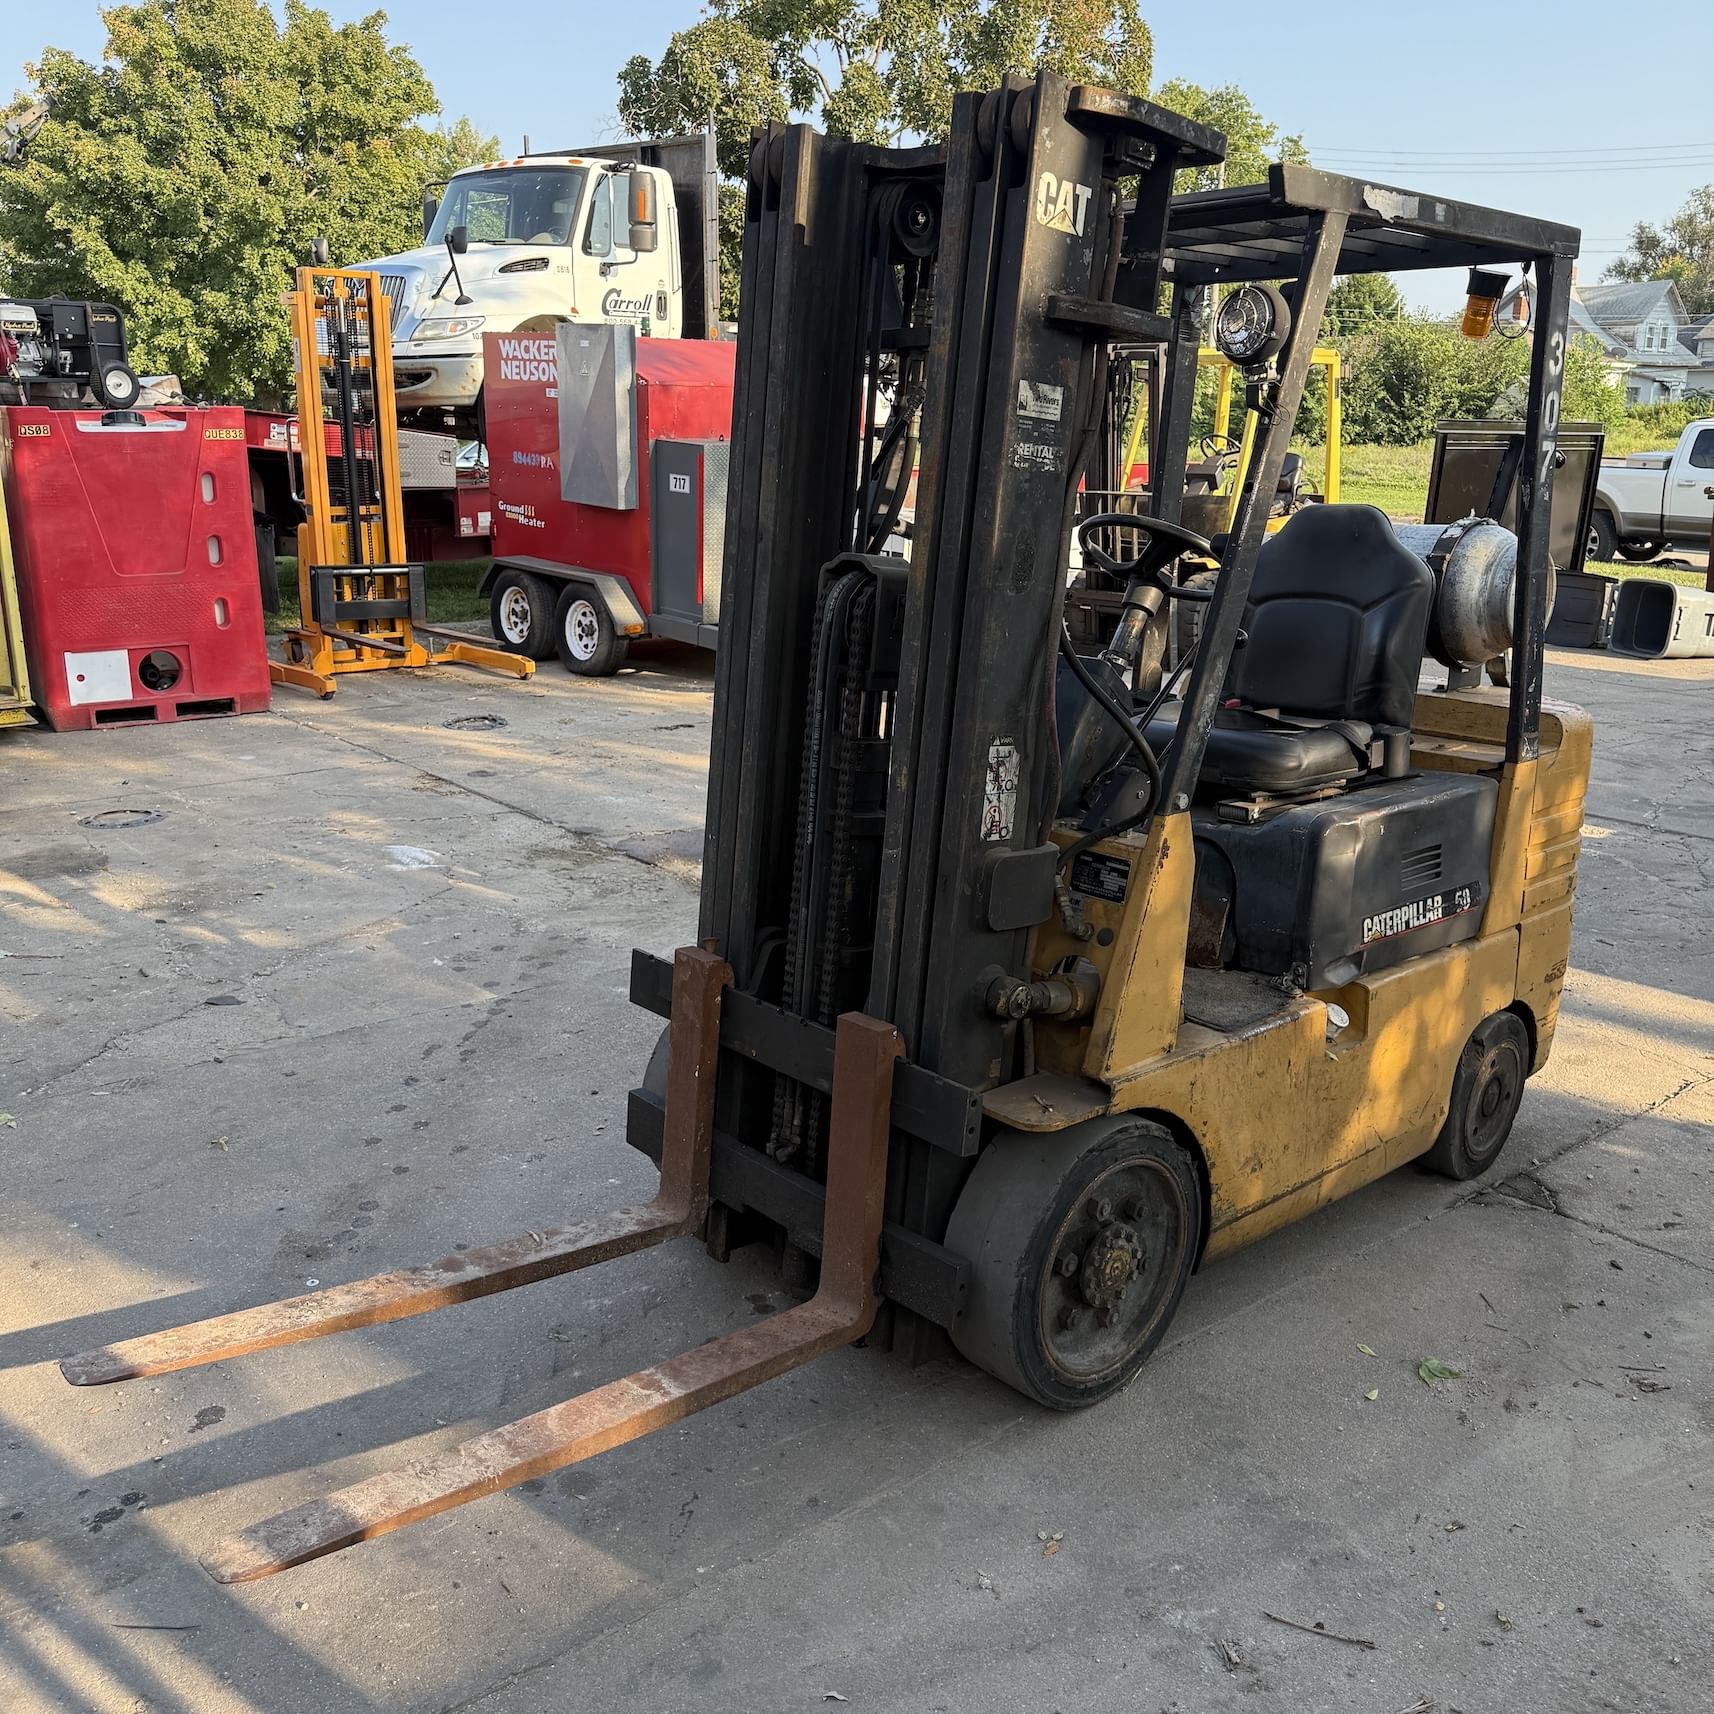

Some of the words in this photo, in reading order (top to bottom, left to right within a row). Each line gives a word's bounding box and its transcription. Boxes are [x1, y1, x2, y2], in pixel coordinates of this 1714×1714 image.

[1036, 171, 1093, 238] CAT
[601, 288, 653, 317] Carroll
[498, 339, 558, 361] WACKER
[500, 359, 559, 383] NEUSON
[1540, 331, 1564, 484] 307
[1017, 442, 1054, 459] RENTAL
[672, 476, 686, 490] 717
[498, 500, 524, 514] Ground
[518, 514, 545, 529] Heater
[1363, 895, 1443, 943] CATERPILLAR
